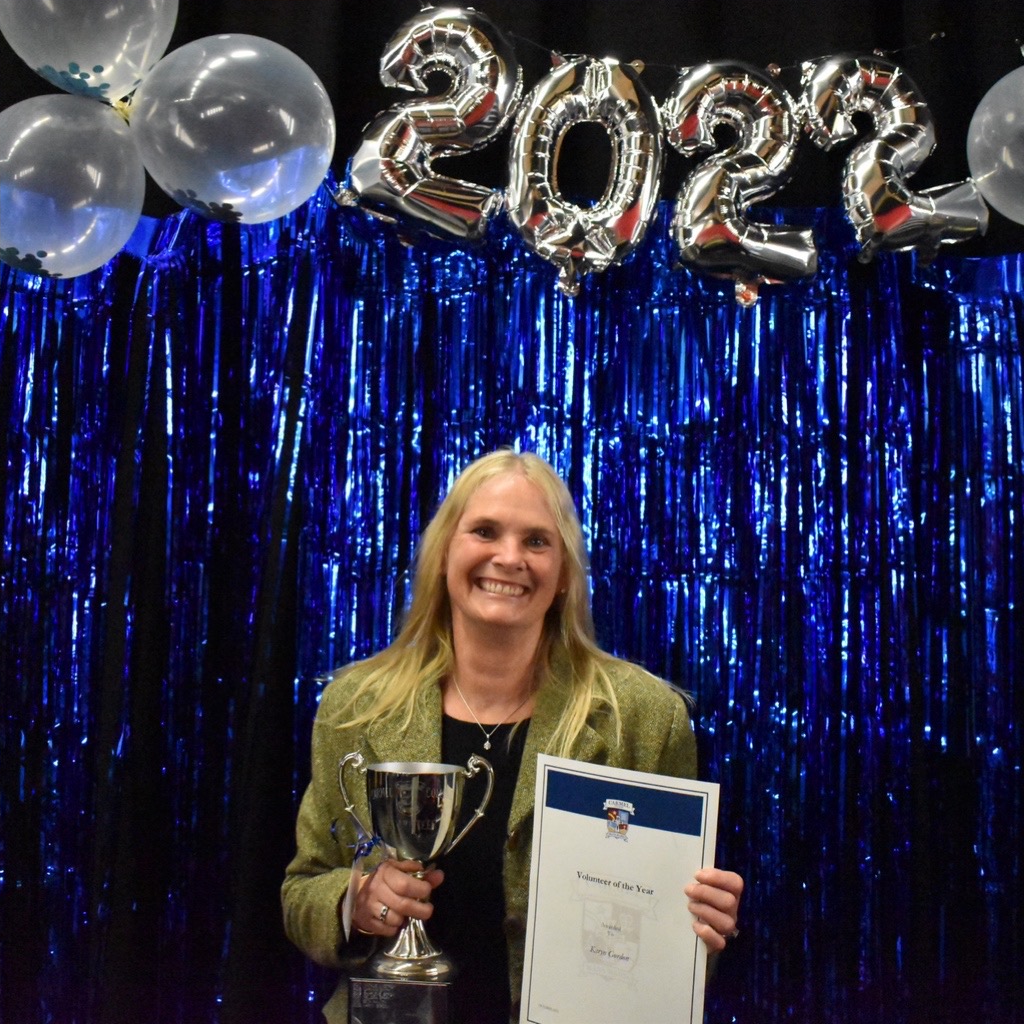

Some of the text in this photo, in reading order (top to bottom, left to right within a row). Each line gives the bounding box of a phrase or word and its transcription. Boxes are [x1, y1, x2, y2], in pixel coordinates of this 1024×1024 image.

[338, 4, 989, 280] 2022
[608, 800, 630, 808] CARMEL
[577, 871, 611, 886] Volunteer
[622, 882, 635, 891] the
[636, 884, 654, 895] Year
